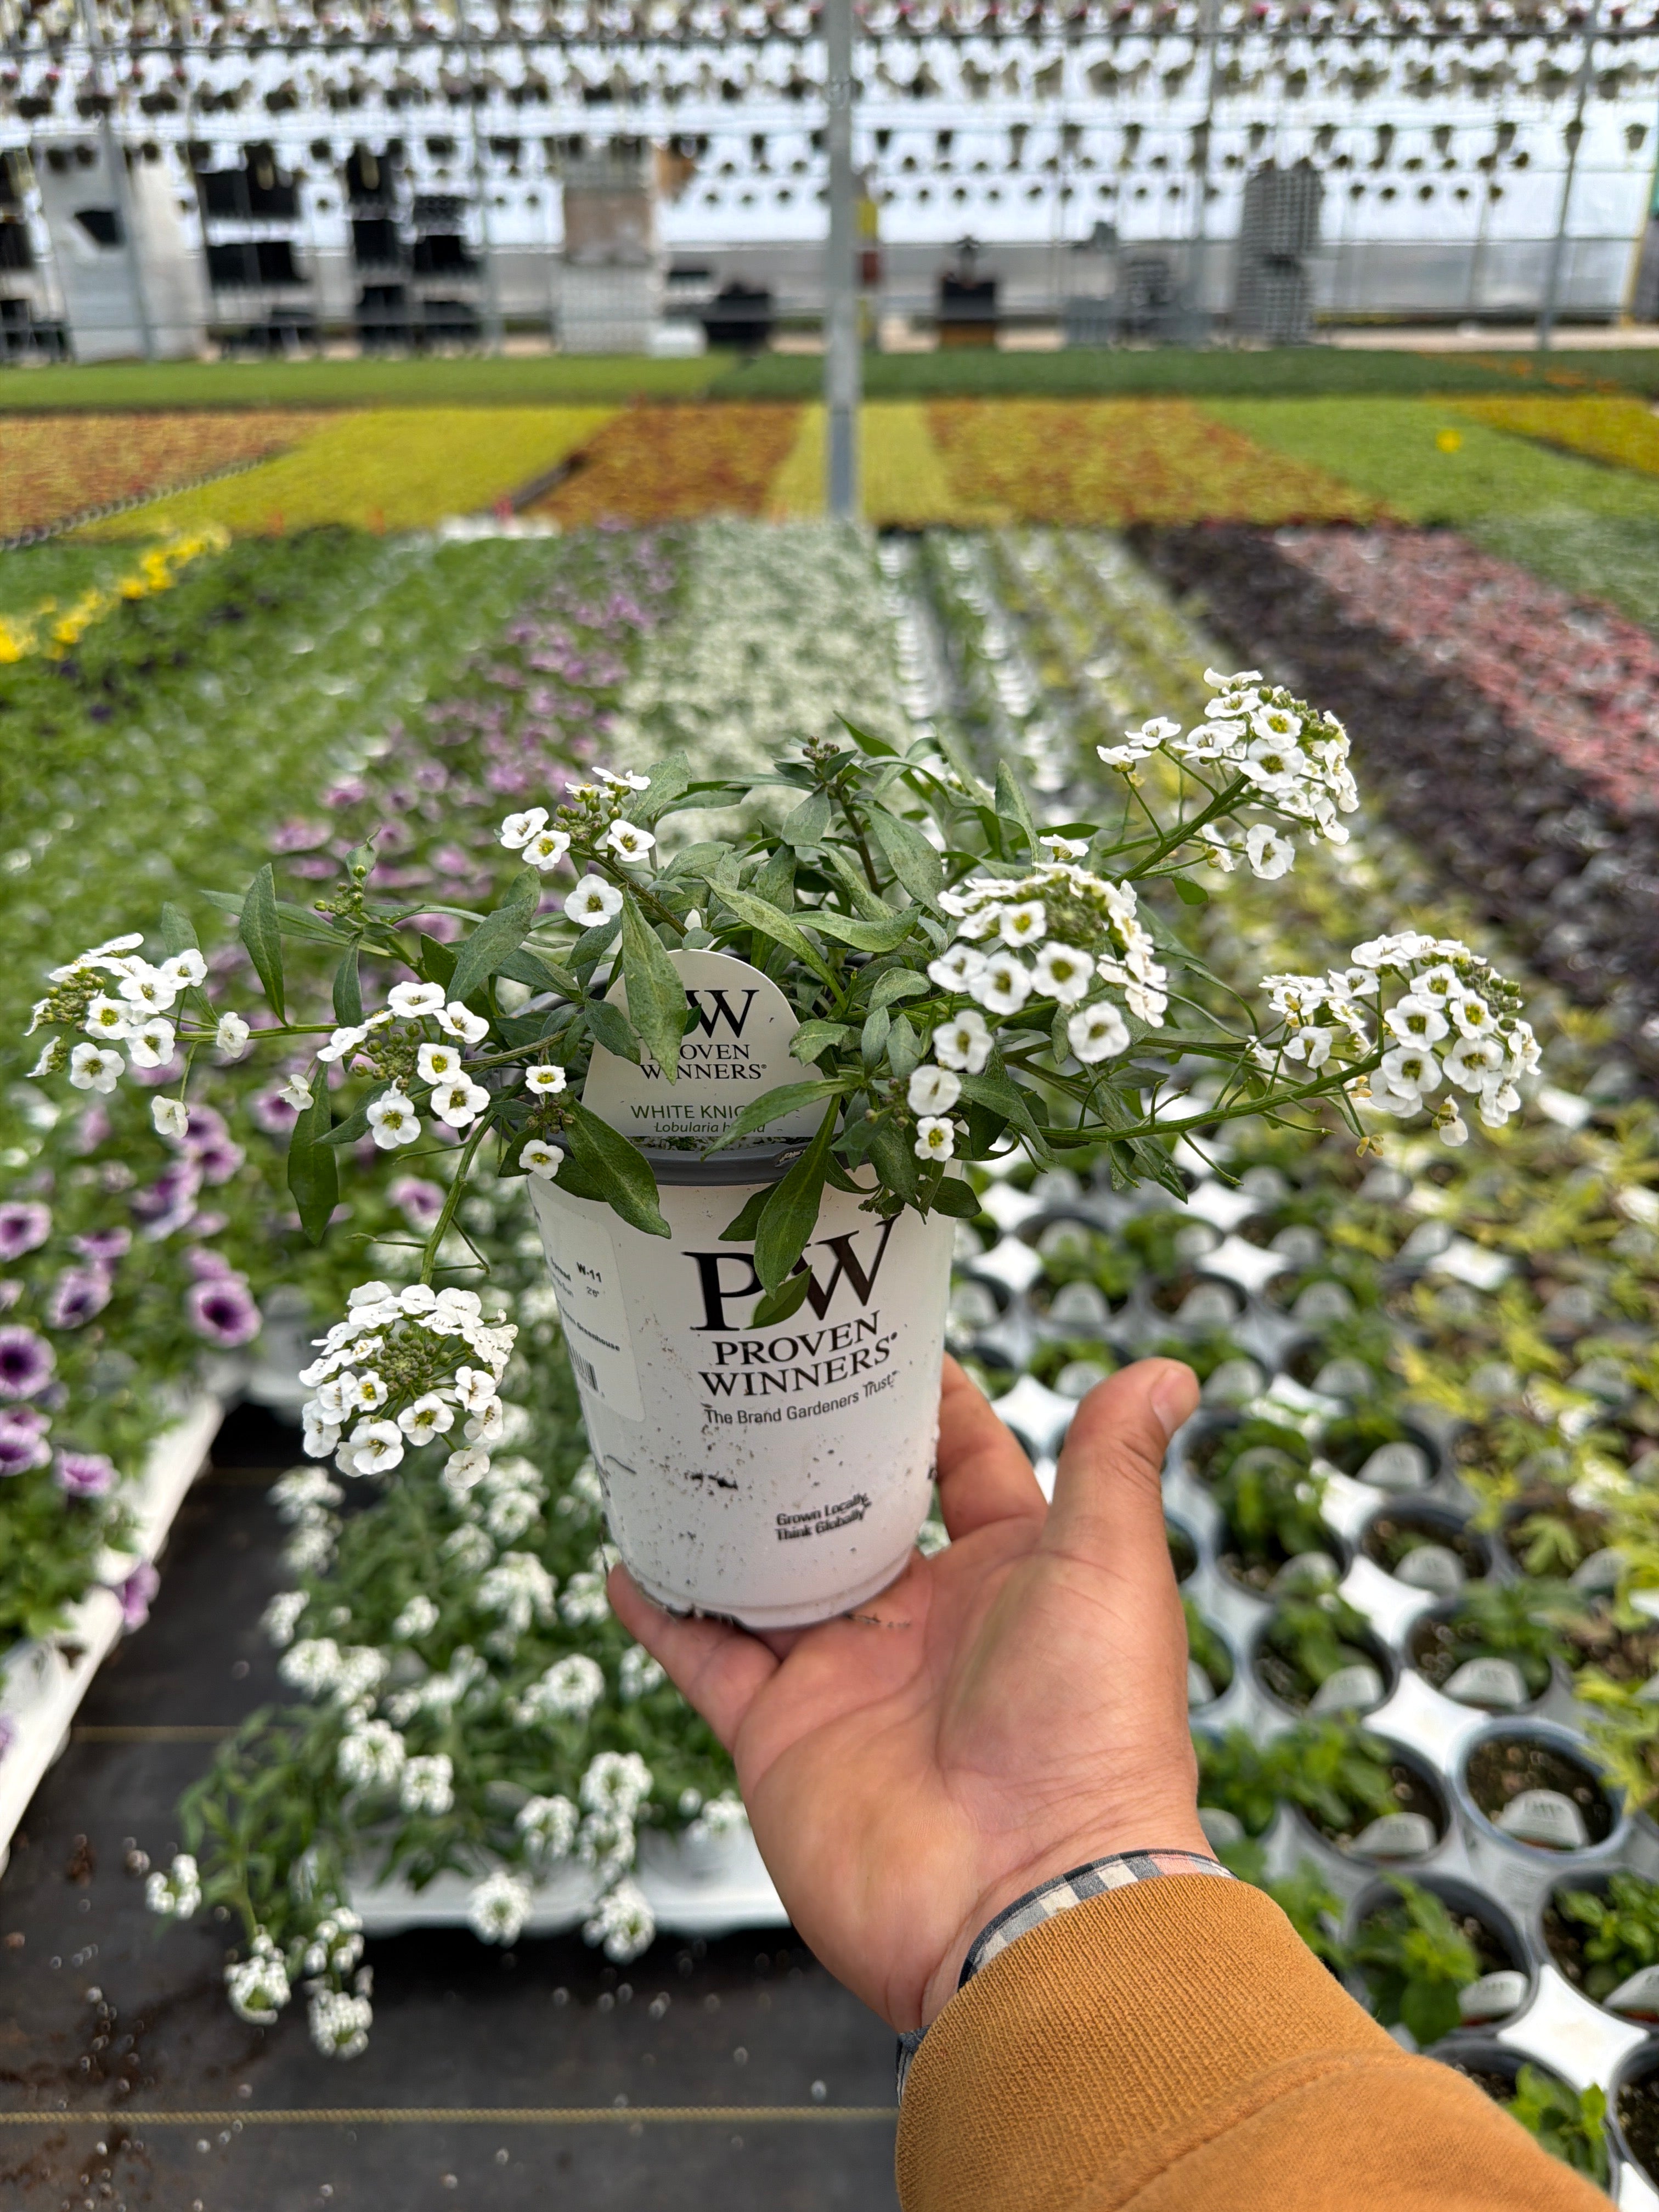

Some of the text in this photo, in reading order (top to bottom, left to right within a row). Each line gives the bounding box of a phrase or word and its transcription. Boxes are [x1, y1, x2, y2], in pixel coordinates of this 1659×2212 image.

[649, 1044, 751, 1060] OVEN
[631, 1105, 695, 1119] WHITE
[655, 1121, 718, 1133] Lobularia
[576, 1322, 620, 1352] Greenhouse
[712, 1310, 881, 1365] PROVEN
[704, 1408, 733, 1425] The
[737, 1407, 782, 1424] Brand
[786, 1391, 860, 1420] Gardeners
[776, 1509, 822, 1526] Grown
[775, 1524, 812, 1541] Think
